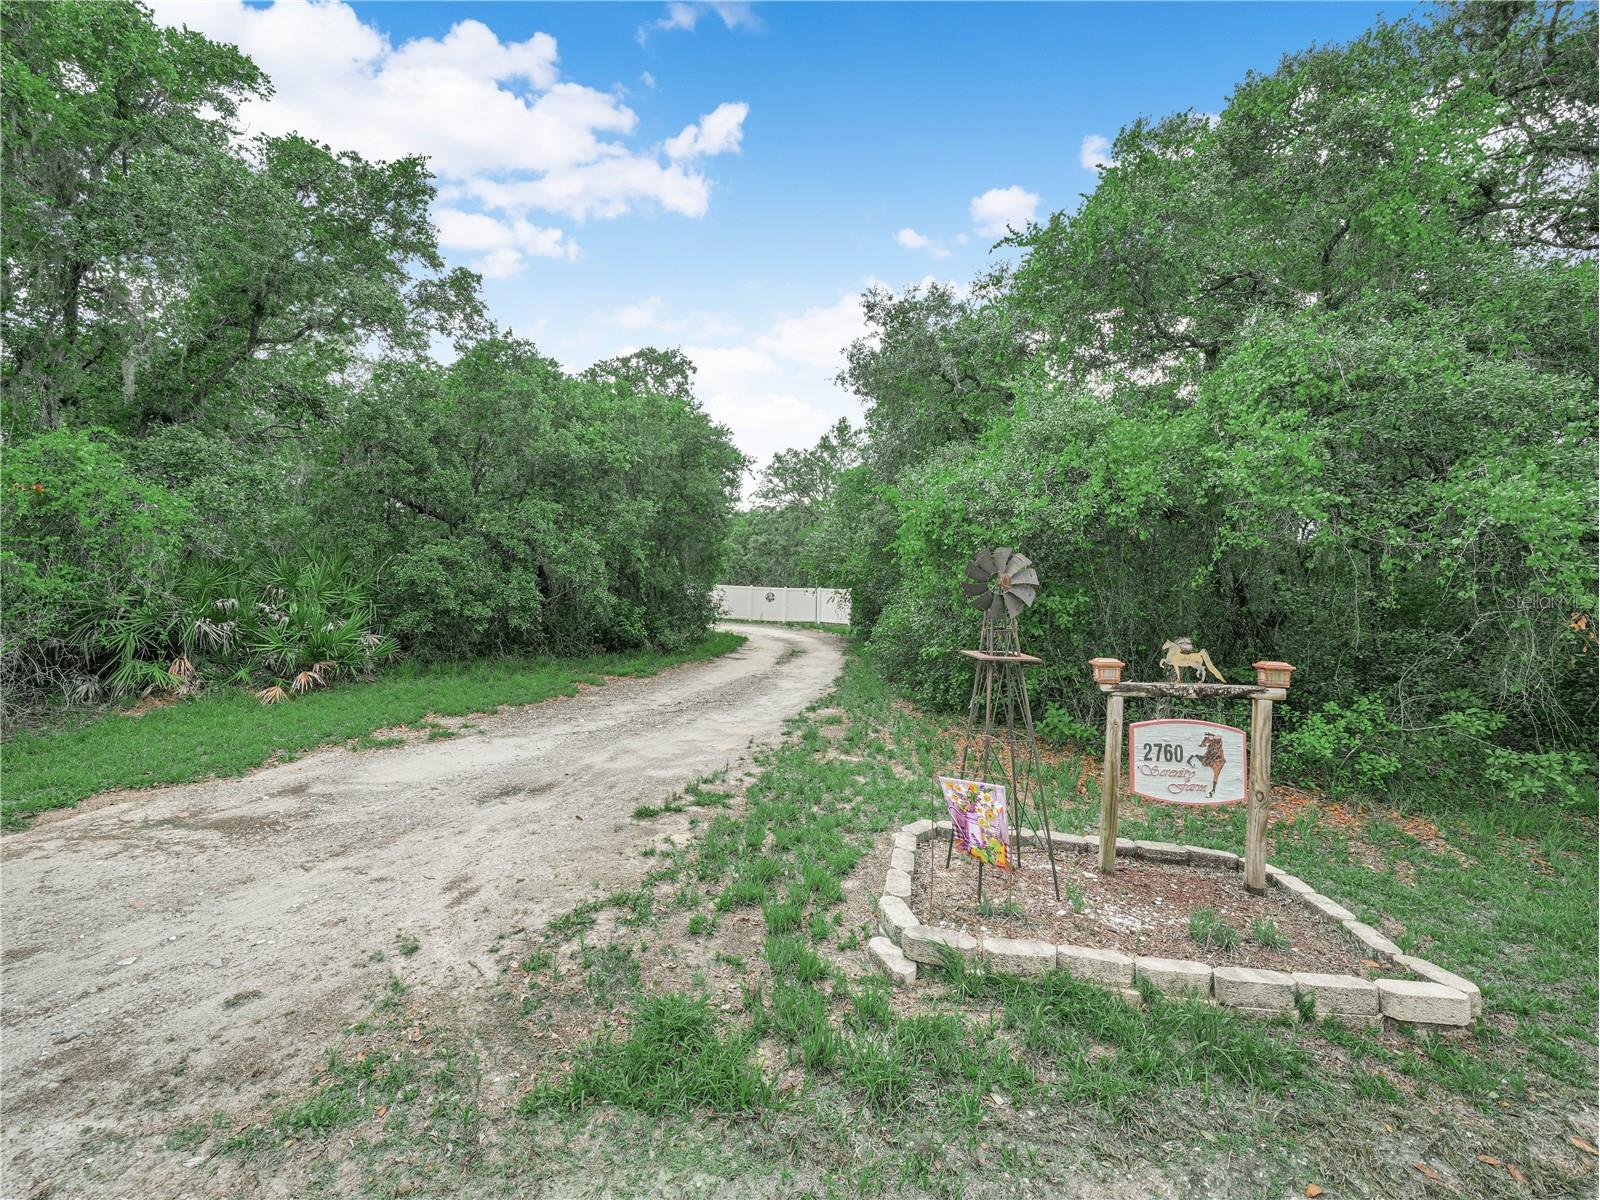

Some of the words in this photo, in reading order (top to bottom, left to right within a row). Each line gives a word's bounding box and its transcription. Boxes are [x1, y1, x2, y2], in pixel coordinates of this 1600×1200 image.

[1143, 743, 1183, 762] 2760
[1141, 764, 1195, 782] Serenity
[1168, 783, 1207, 794] Farm
